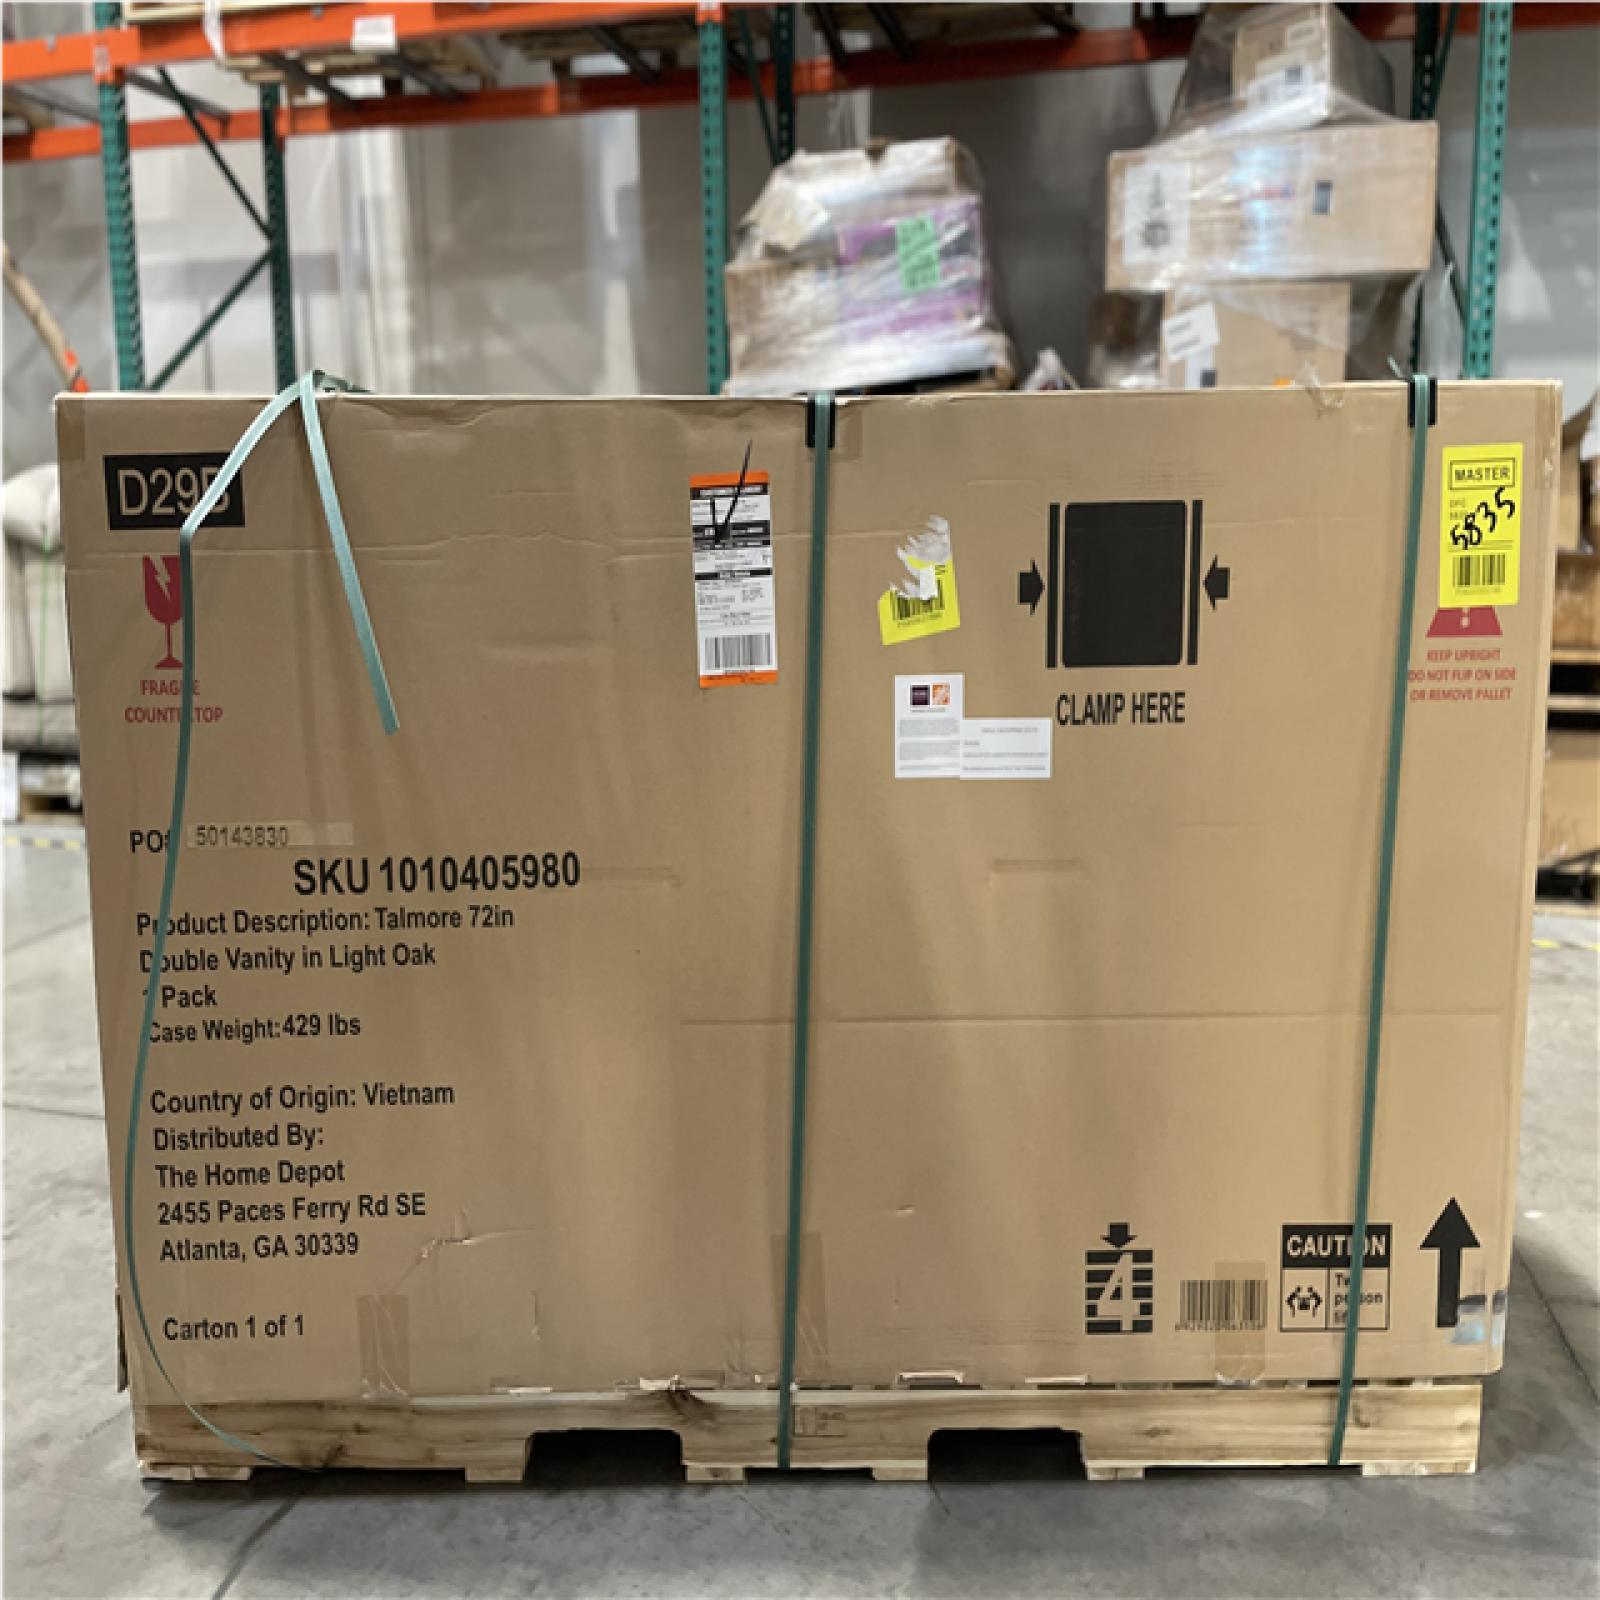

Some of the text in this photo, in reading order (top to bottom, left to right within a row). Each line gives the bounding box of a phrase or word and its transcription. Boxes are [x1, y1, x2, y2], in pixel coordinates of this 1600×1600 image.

[1454, 466, 1511, 482] MASTER
[1427, 648, 1501, 661] KEEP UPRIGHT
[141, 679, 201, 696] FRAGE
[1427, 669, 1450, 682] NOT
[1452, 669, 1473, 681] FLIP
[1474, 669, 1491, 681] ON
[1494, 667, 1516, 681] SIDE
[1056, 690, 1186, 726] CLAMP HERE
[1410, 687, 1511, 702] OR REMOVE PALLET
[293, 850, 580, 896] SKU 1010405980
[233, 907, 370, 938] Description:
[374, 906, 463, 931] Talmore
[468, 904, 515, 928] 72in
[224, 944, 296, 976] Vanity
[301, 944, 323, 969] in
[329, 943, 386, 974] Light
[392, 942, 436, 967] Oak
[161, 983, 218, 1009] Pack
[327, 1011, 361, 1036] lbs
[150, 1081, 456, 1118] Country of Origin: Vietnam
[153, 1122, 324, 1151] Distributed By:
[155, 1160, 346, 1188] The Home Depot
[157, 1192, 427, 1225] 2455 Paces Ferry Rd SE
[159, 1231, 359, 1263] Atlanta, GA 30339
[162, 1313, 304, 1342] Carton 1 of 1
